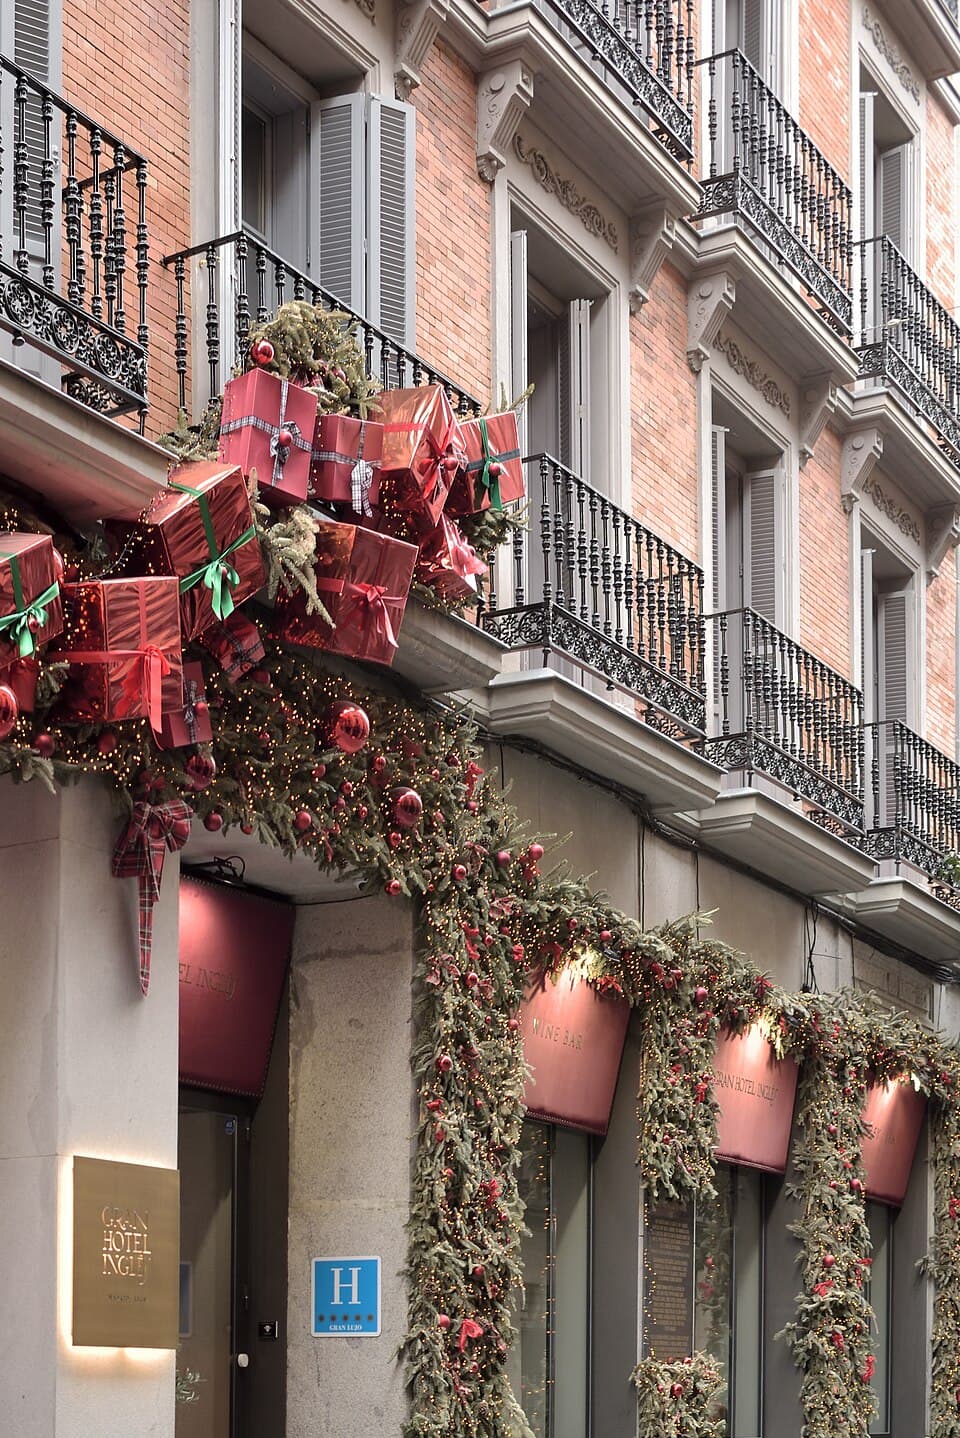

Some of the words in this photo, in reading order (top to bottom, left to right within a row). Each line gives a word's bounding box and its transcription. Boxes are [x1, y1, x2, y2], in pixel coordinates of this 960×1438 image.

[531, 1016, 561, 1042] WINE
[562, 1028, 584, 1051] BAR
[734, 1075, 756, 1096] HOTEL
[101, 1206, 149, 1231] GRAN
[102, 1230, 152, 1255] HOTEL
[330, 1267, 362, 1305] H
